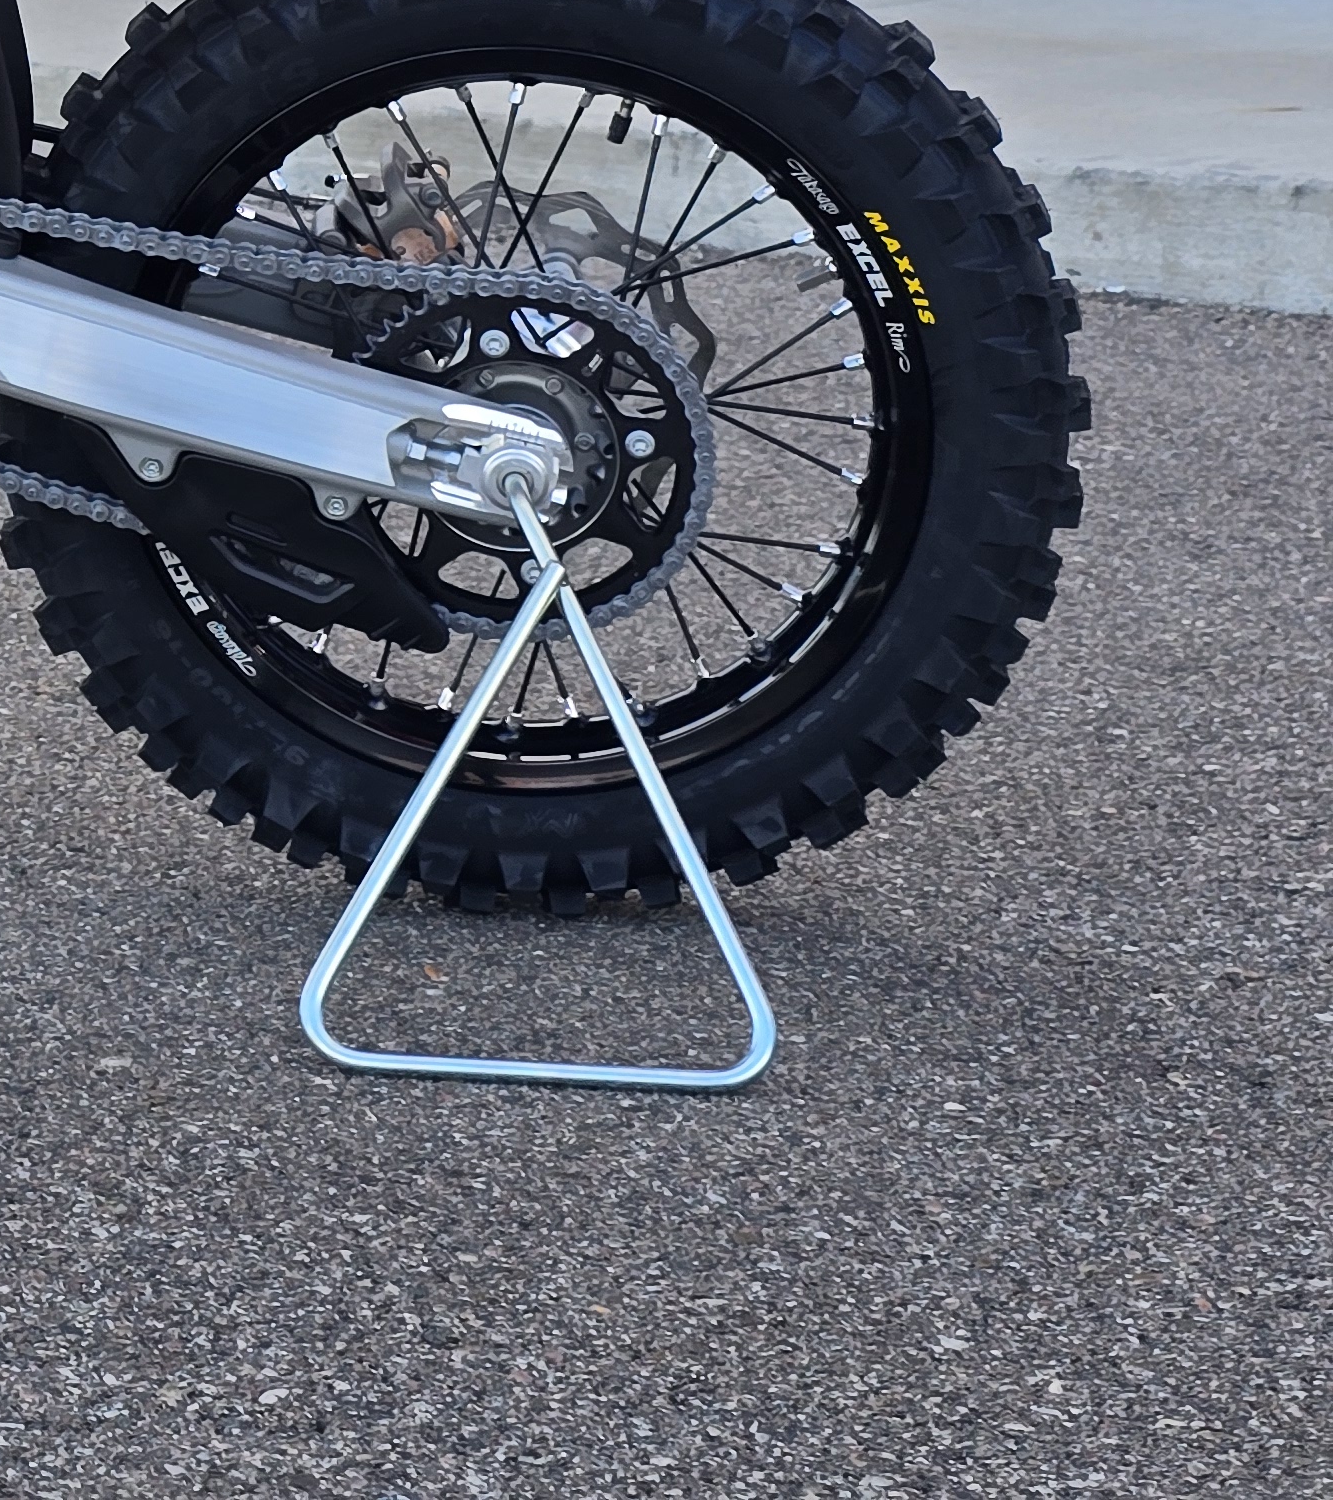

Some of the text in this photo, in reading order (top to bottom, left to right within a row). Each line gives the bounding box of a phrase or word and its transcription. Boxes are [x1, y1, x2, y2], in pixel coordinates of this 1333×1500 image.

[835, 222, 894, 308] EXCEL
[885, 321, 911, 374] Rim
[863, 211, 936, 325] MAXXIS
